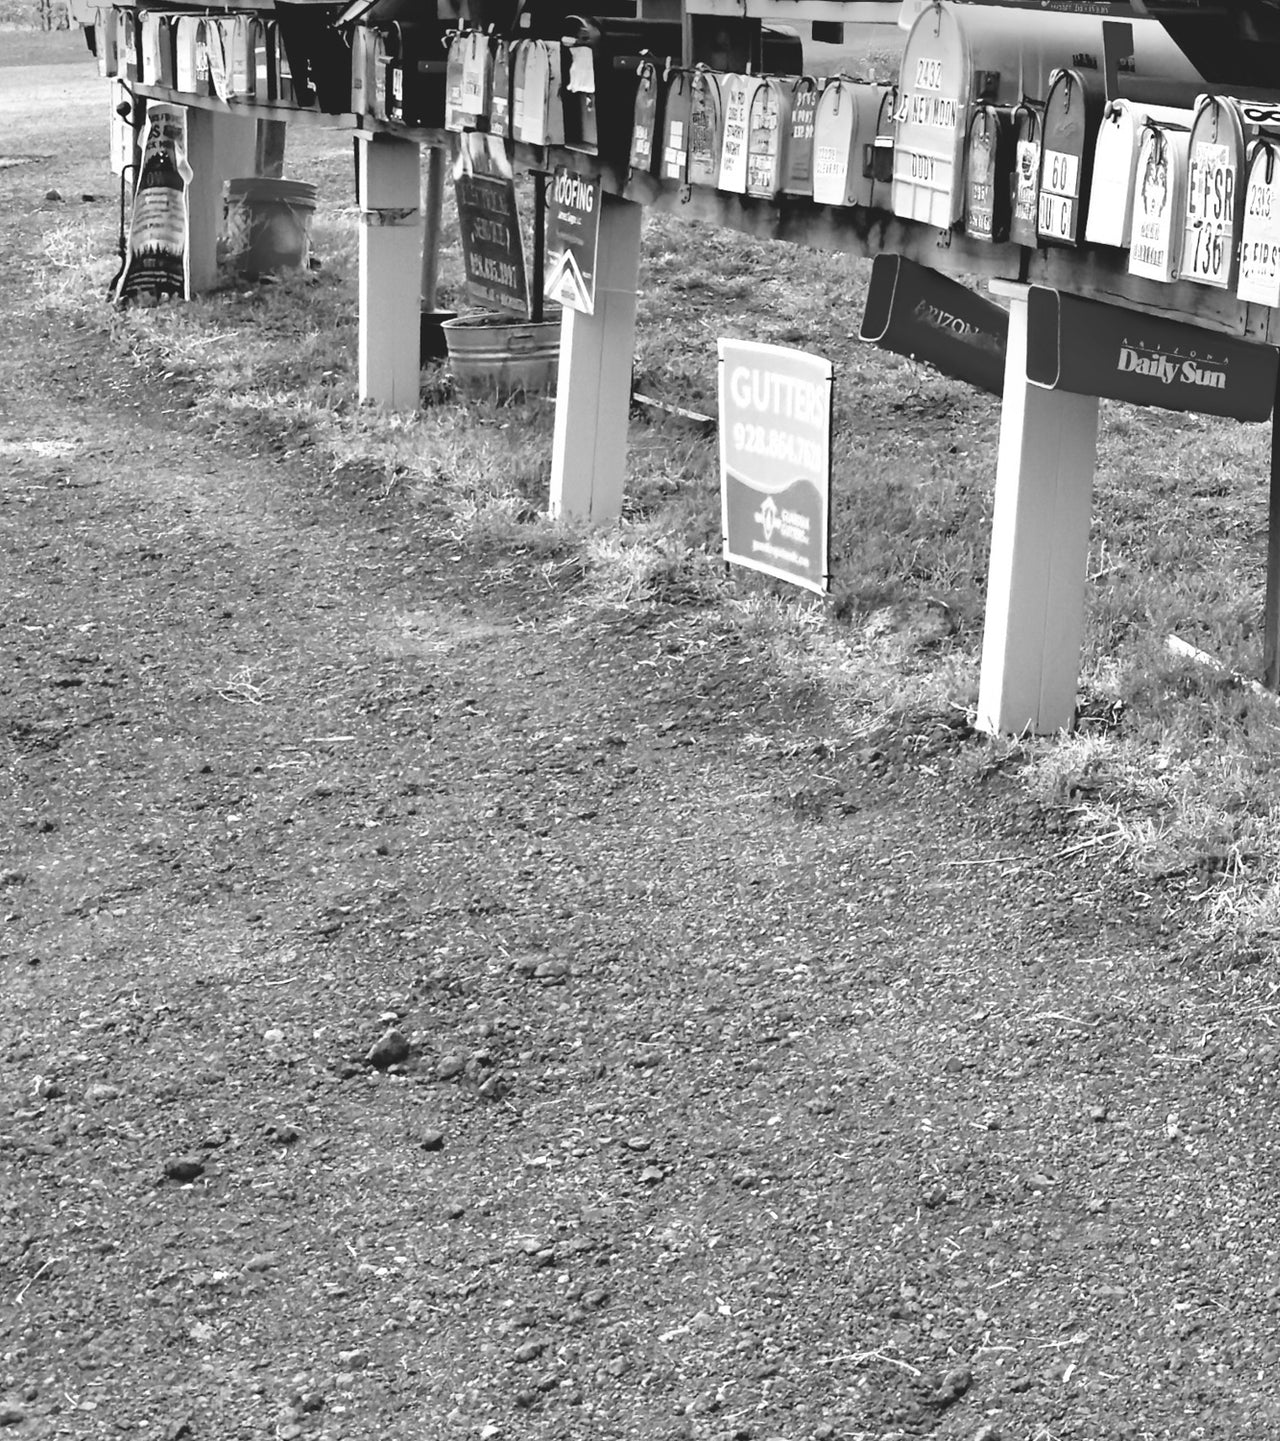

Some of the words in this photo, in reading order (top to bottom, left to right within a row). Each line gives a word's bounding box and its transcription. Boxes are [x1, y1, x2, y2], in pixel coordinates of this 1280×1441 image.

[1193, 220, 1223, 275] 736
[1117, 347, 1180, 384] Daily
[1180, 360, 1227, 389] Sun
[730, 366, 824, 428] GUTTERS
